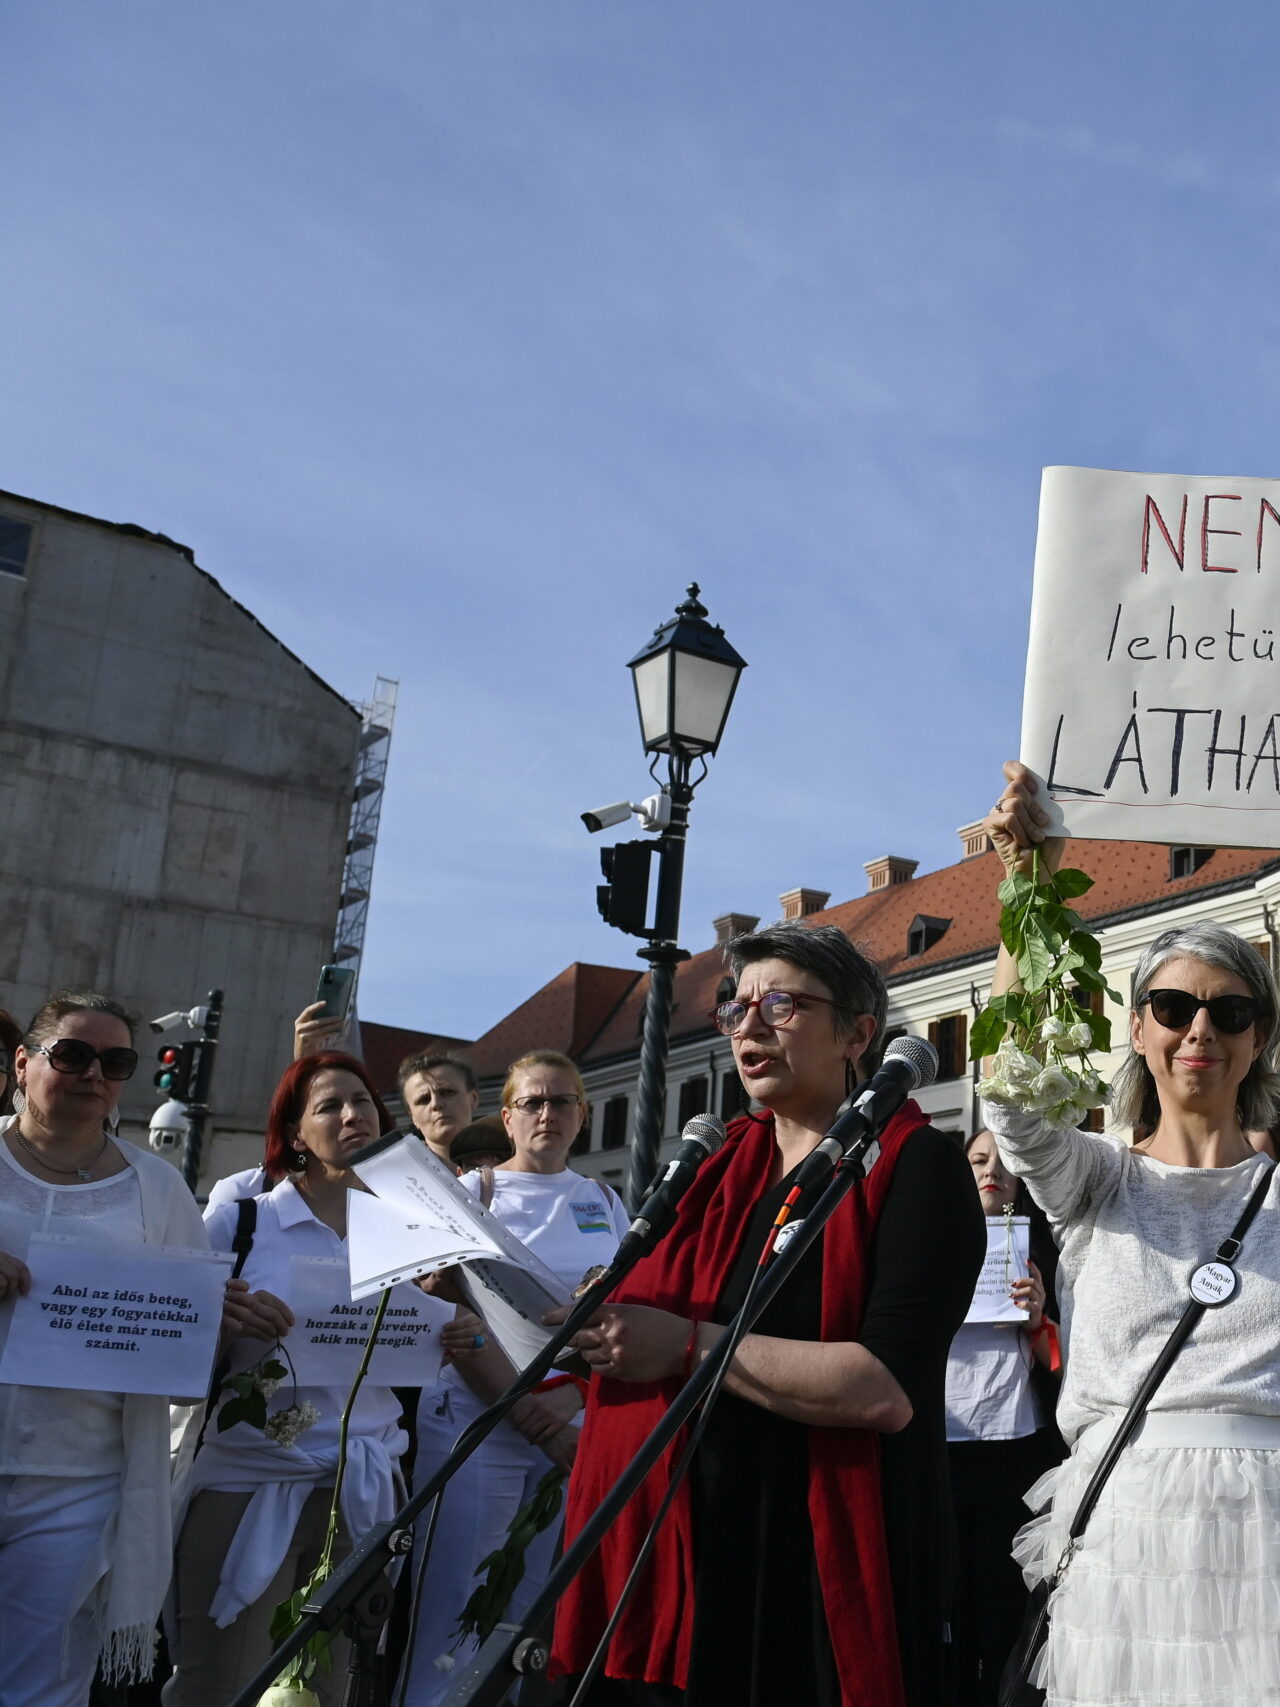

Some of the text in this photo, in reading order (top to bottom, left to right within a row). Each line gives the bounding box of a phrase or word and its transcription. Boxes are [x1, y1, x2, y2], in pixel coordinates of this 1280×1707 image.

[1204, 1266, 1232, 1284] Magyar
[1198, 1278, 1222, 1295] Anyák
[52, 1285, 192, 1309] Ahol az idős beteg,
[40, 1302, 198, 1323] vagy egy fogyatékkal
[330, 1304, 419, 1317] Ahol olanok
[50, 1318, 182, 1338] élő élete már nem
[305, 1319, 356, 1330] hozzák
[372, 1322, 431, 1335] örvényt,
[85, 1338, 140, 1351] számít.
[310, 1334, 342, 1344] akik
